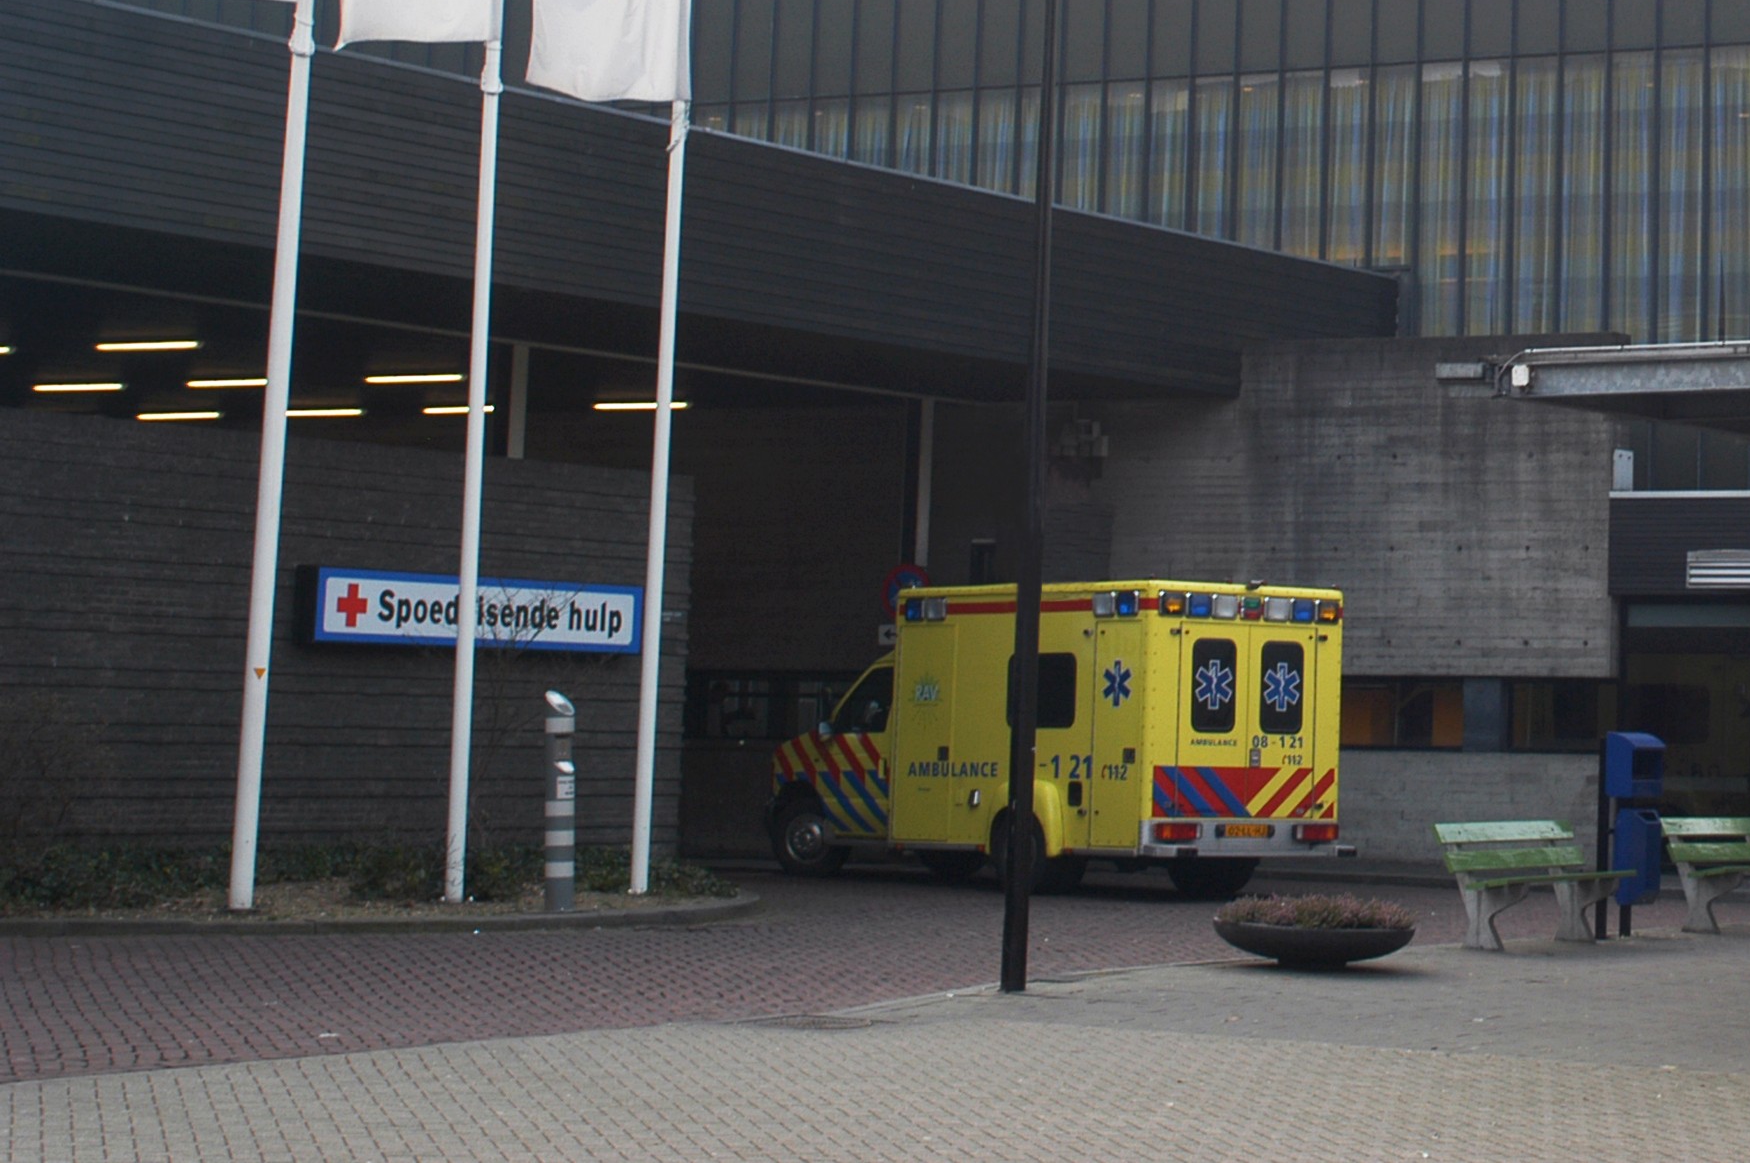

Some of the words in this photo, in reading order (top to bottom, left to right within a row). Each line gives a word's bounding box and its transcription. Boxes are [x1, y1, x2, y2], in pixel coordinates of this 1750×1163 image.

[377, 588, 560, 630] Spoedisende
[568, 600, 623, 639] hulp
[908, 761, 999, 778] AMBULANCE
[1107, 764, 1129, 780] 112
